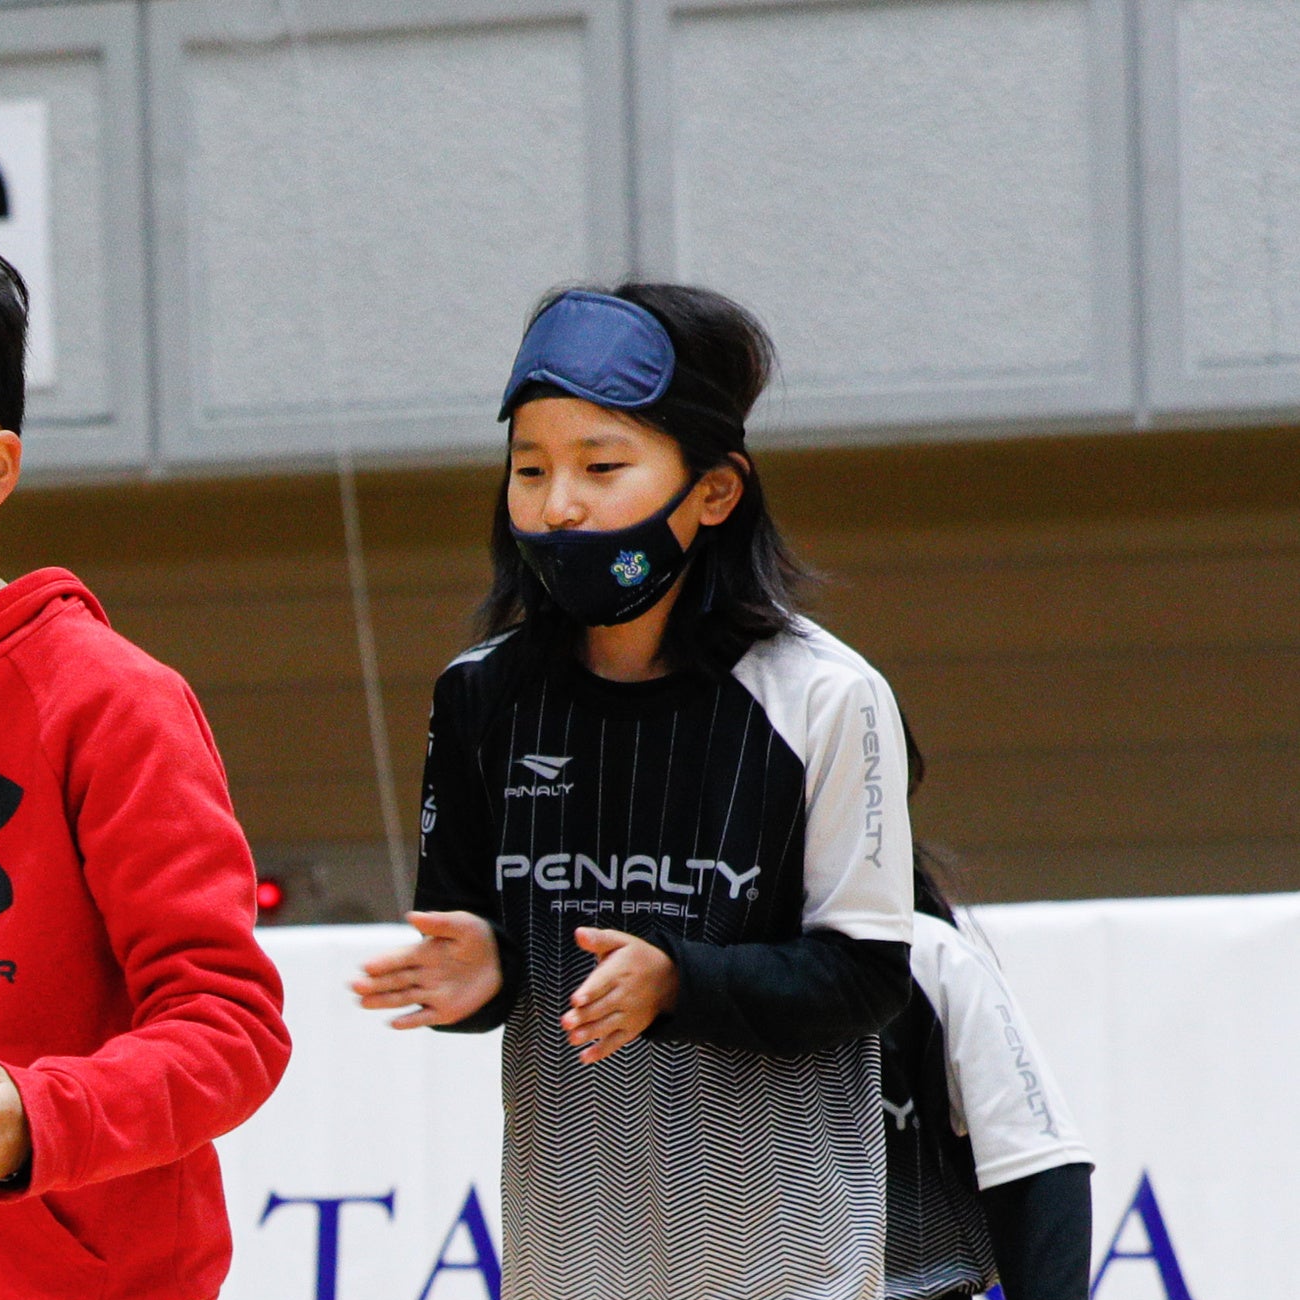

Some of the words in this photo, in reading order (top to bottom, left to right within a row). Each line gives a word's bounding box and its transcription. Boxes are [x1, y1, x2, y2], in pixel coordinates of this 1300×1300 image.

[503, 782, 574, 800] PENALTY
[859, 704, 882, 869] PENALTY
[496, 853, 761, 899] PENALTY
[621, 901, 698, 918] BRASIL
[994, 1003, 1059, 1139] PENALTY
